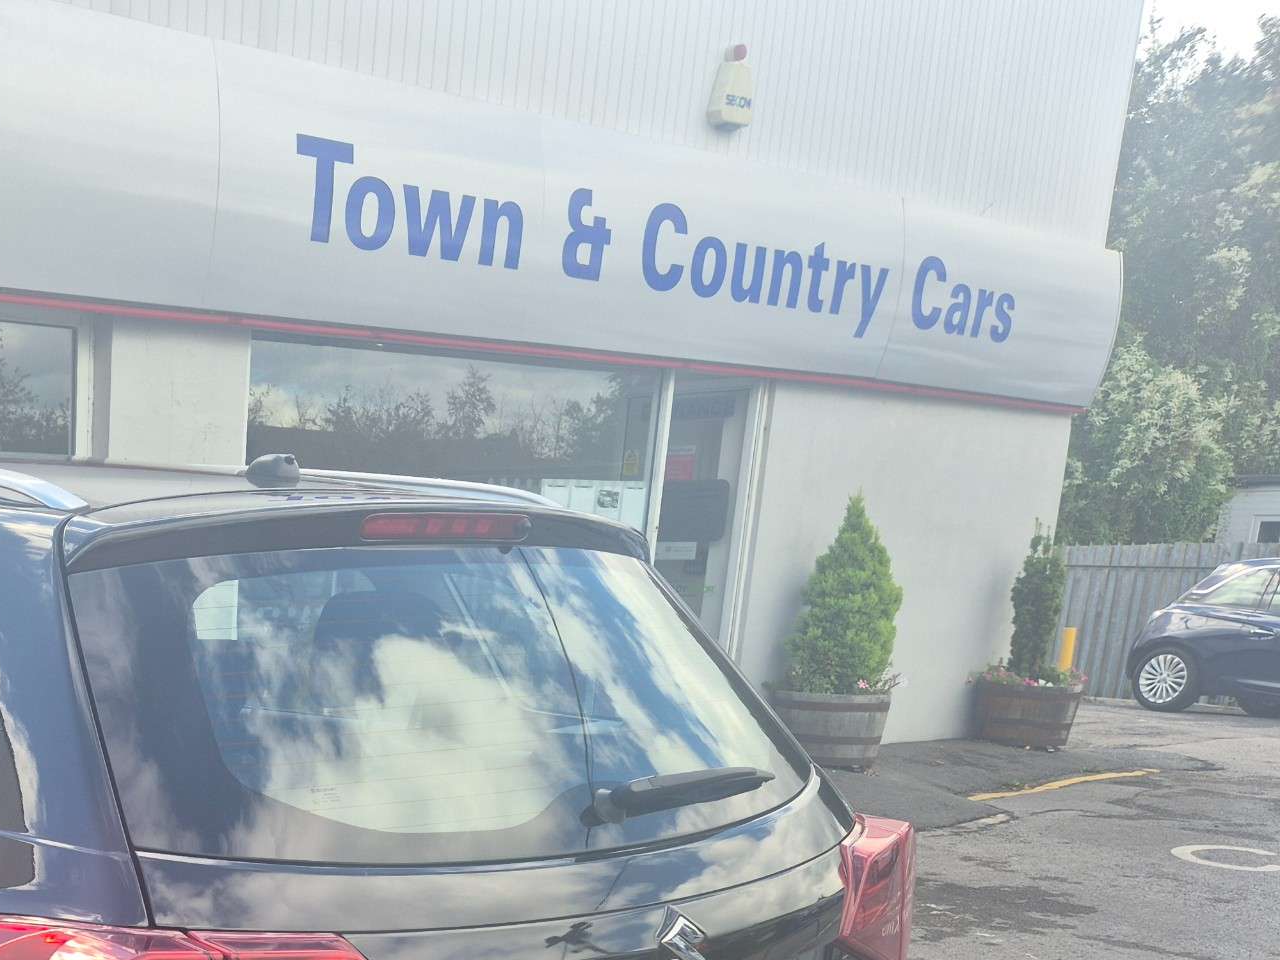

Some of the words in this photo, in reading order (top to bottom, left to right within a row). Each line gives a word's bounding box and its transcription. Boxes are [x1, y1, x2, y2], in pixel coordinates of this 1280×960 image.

[296, 133, 524, 271] Town
[561, 187, 612, 283] &
[642, 202, 890, 339] Country
[911, 255, 1016, 343] Cars
